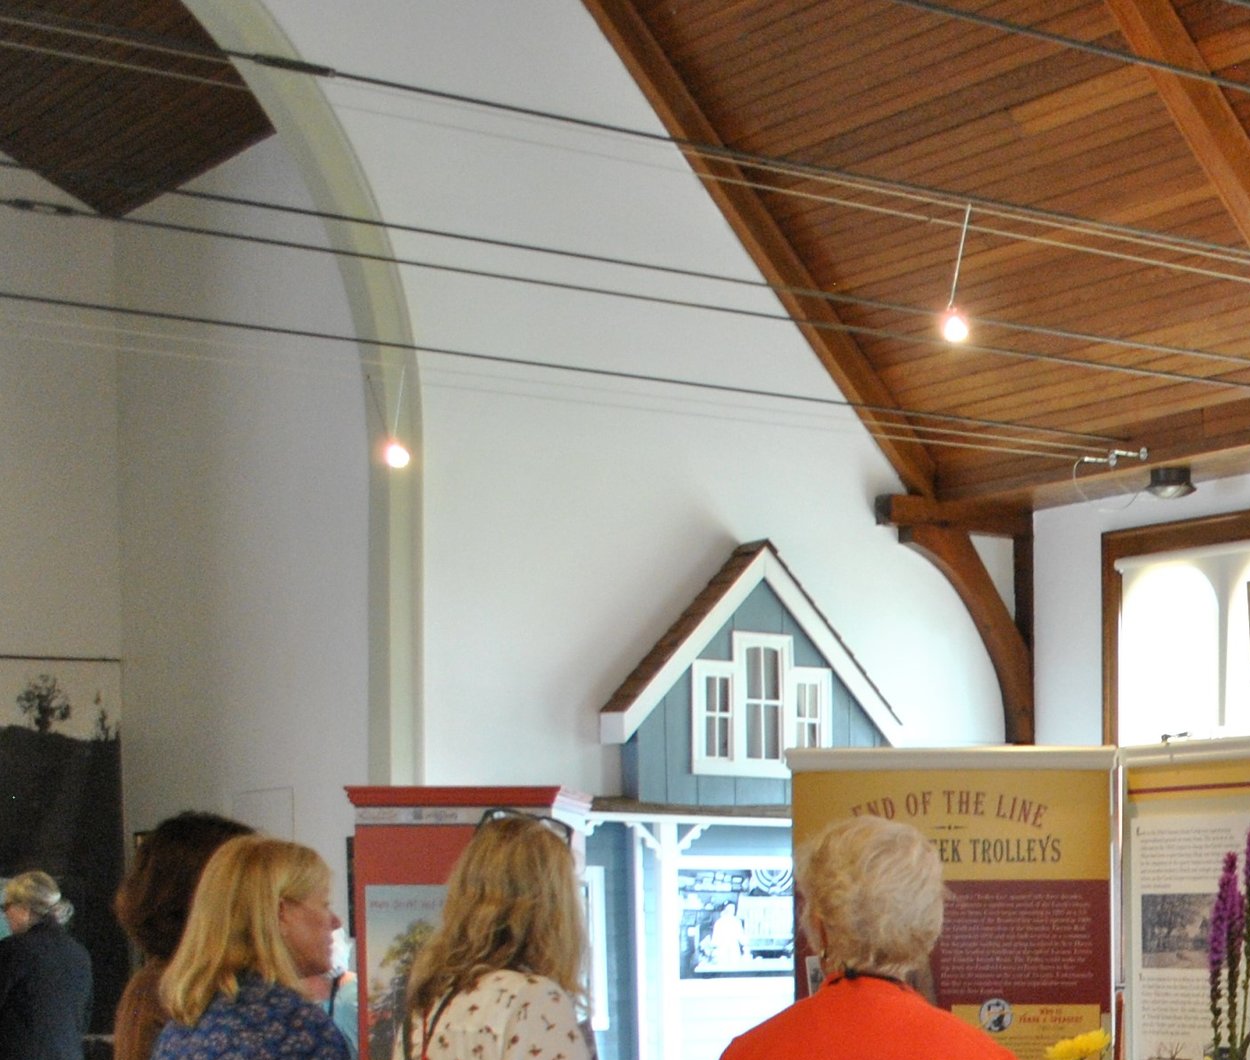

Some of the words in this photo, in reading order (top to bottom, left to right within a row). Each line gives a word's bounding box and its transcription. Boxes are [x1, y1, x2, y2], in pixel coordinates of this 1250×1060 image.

[905, 791, 932, 817] OF
[942, 790, 986, 816] THE
[995, 794, 1048, 828] LINE
